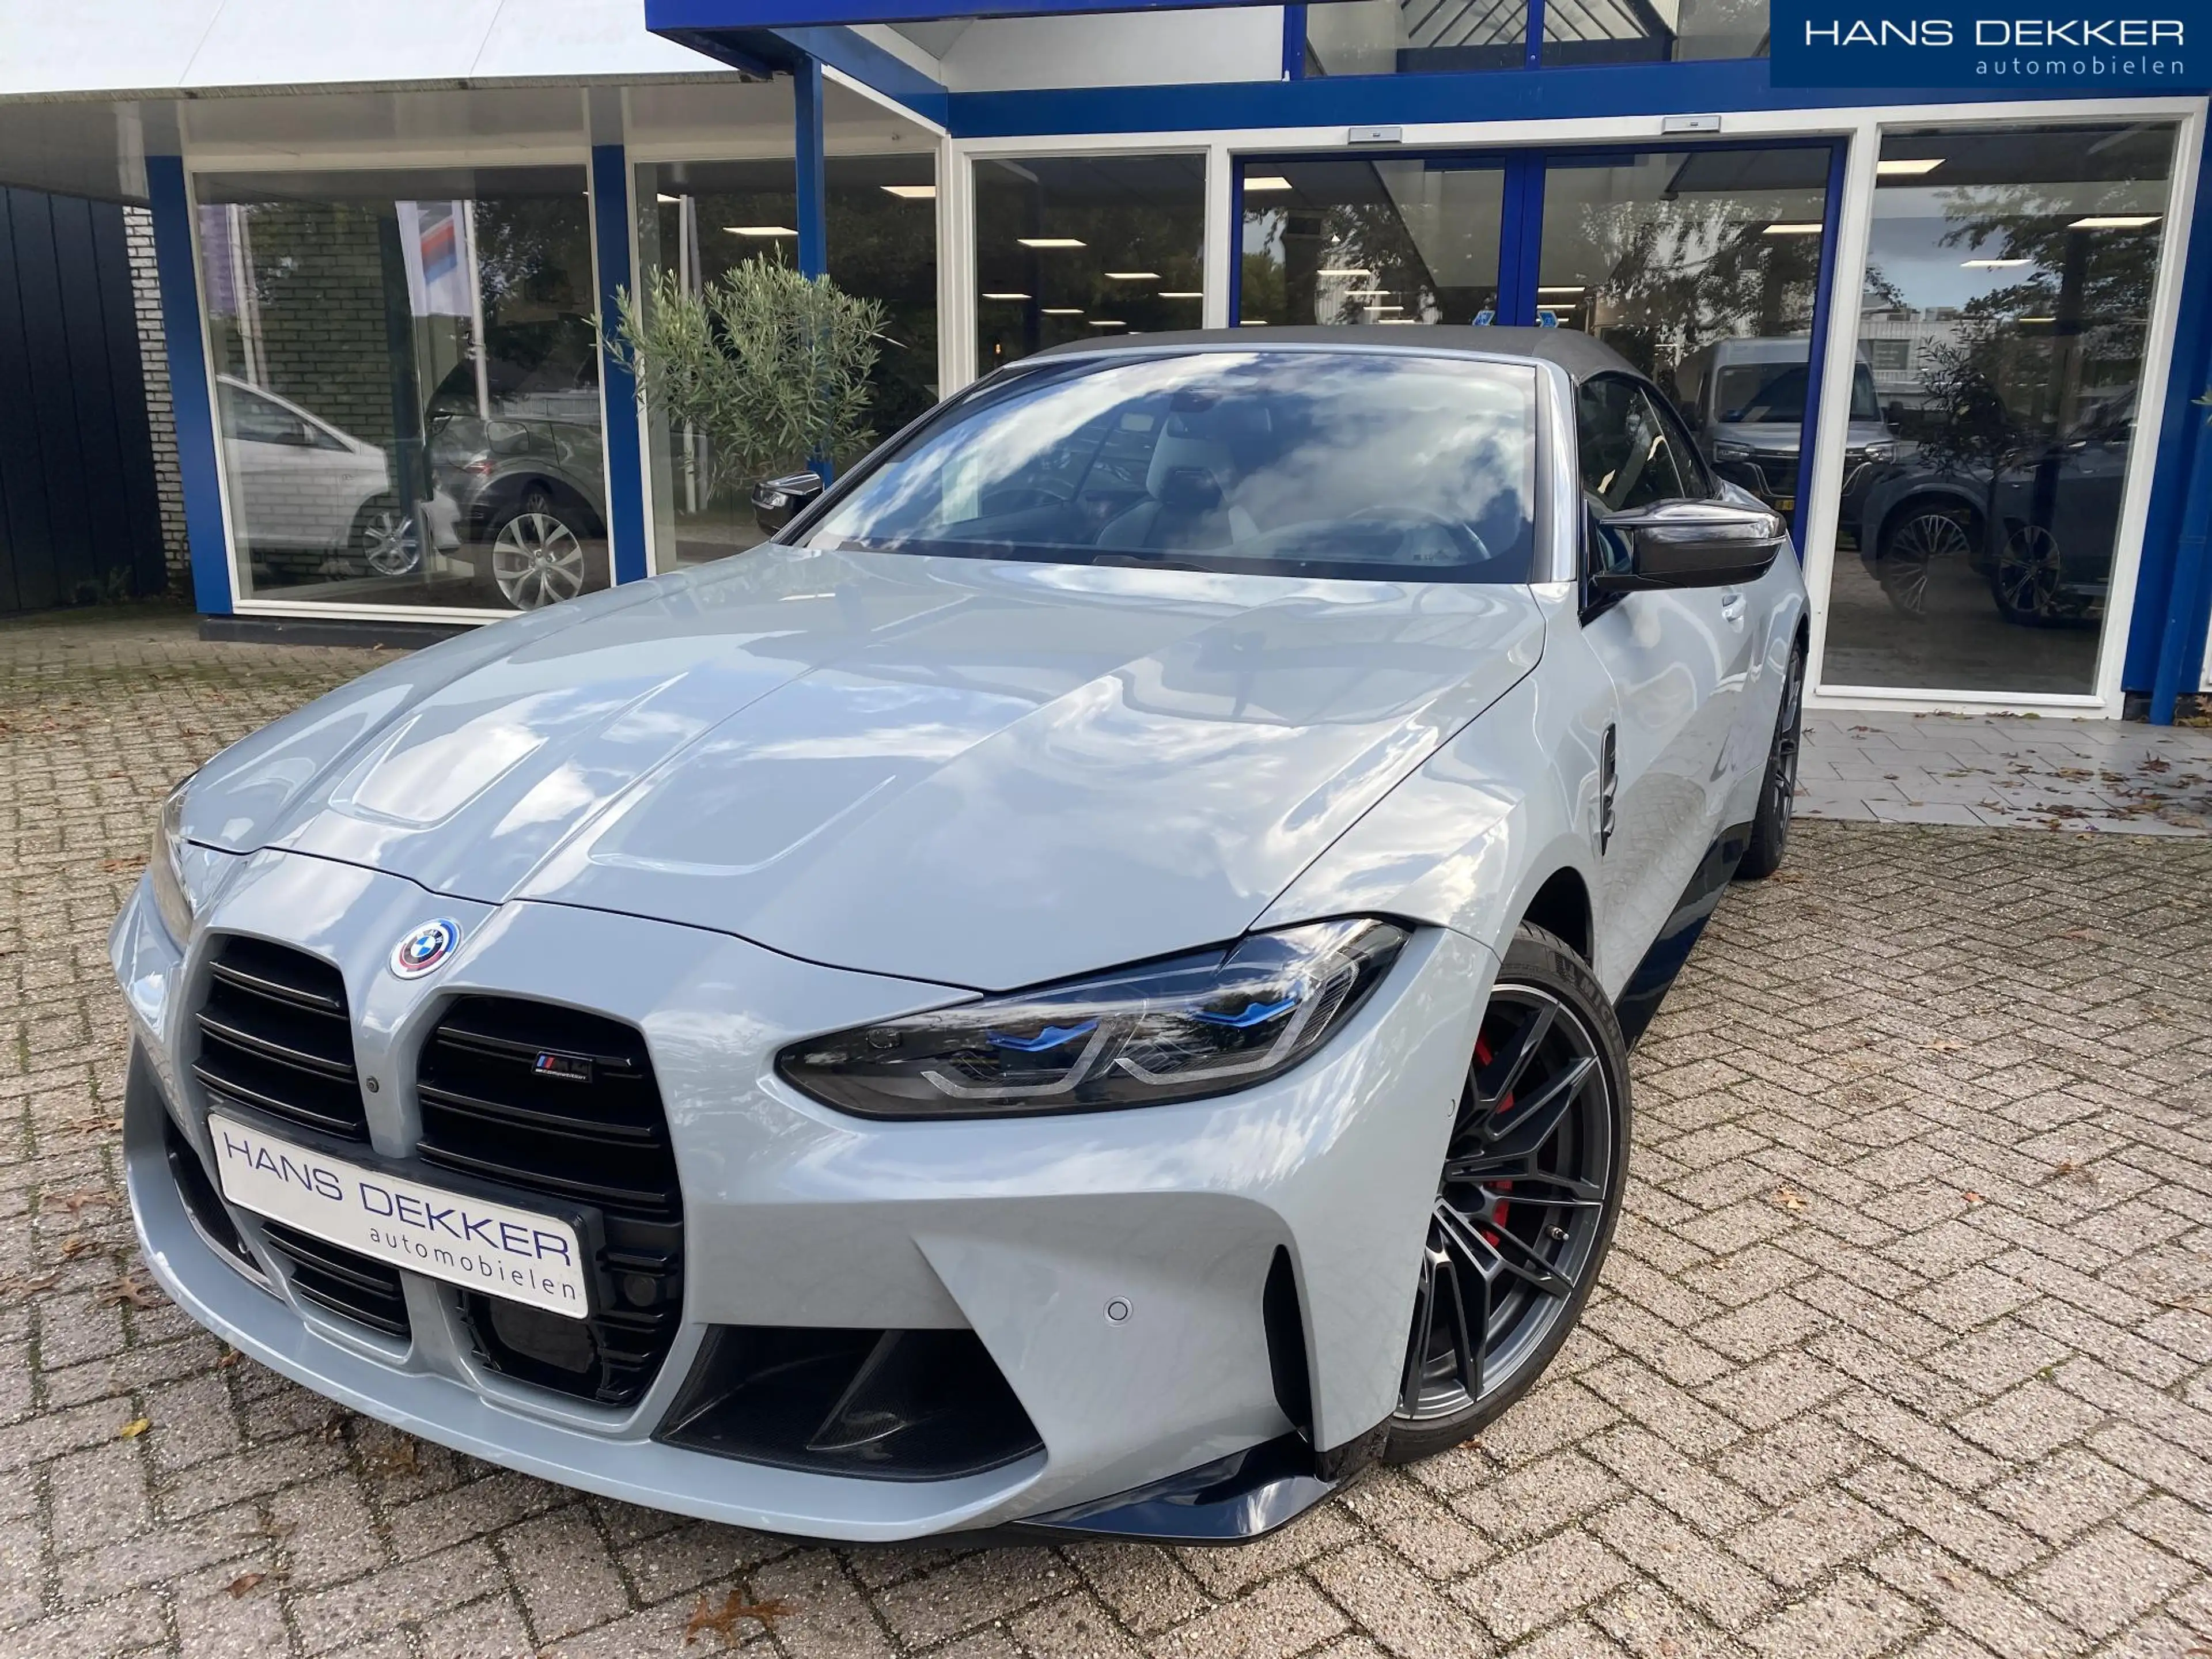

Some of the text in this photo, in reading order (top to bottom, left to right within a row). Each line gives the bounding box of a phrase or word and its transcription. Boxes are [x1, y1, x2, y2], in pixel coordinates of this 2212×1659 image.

[224, 1131, 571, 1267] HANS DEKKER
[370, 1227, 576, 1301] automobielen
